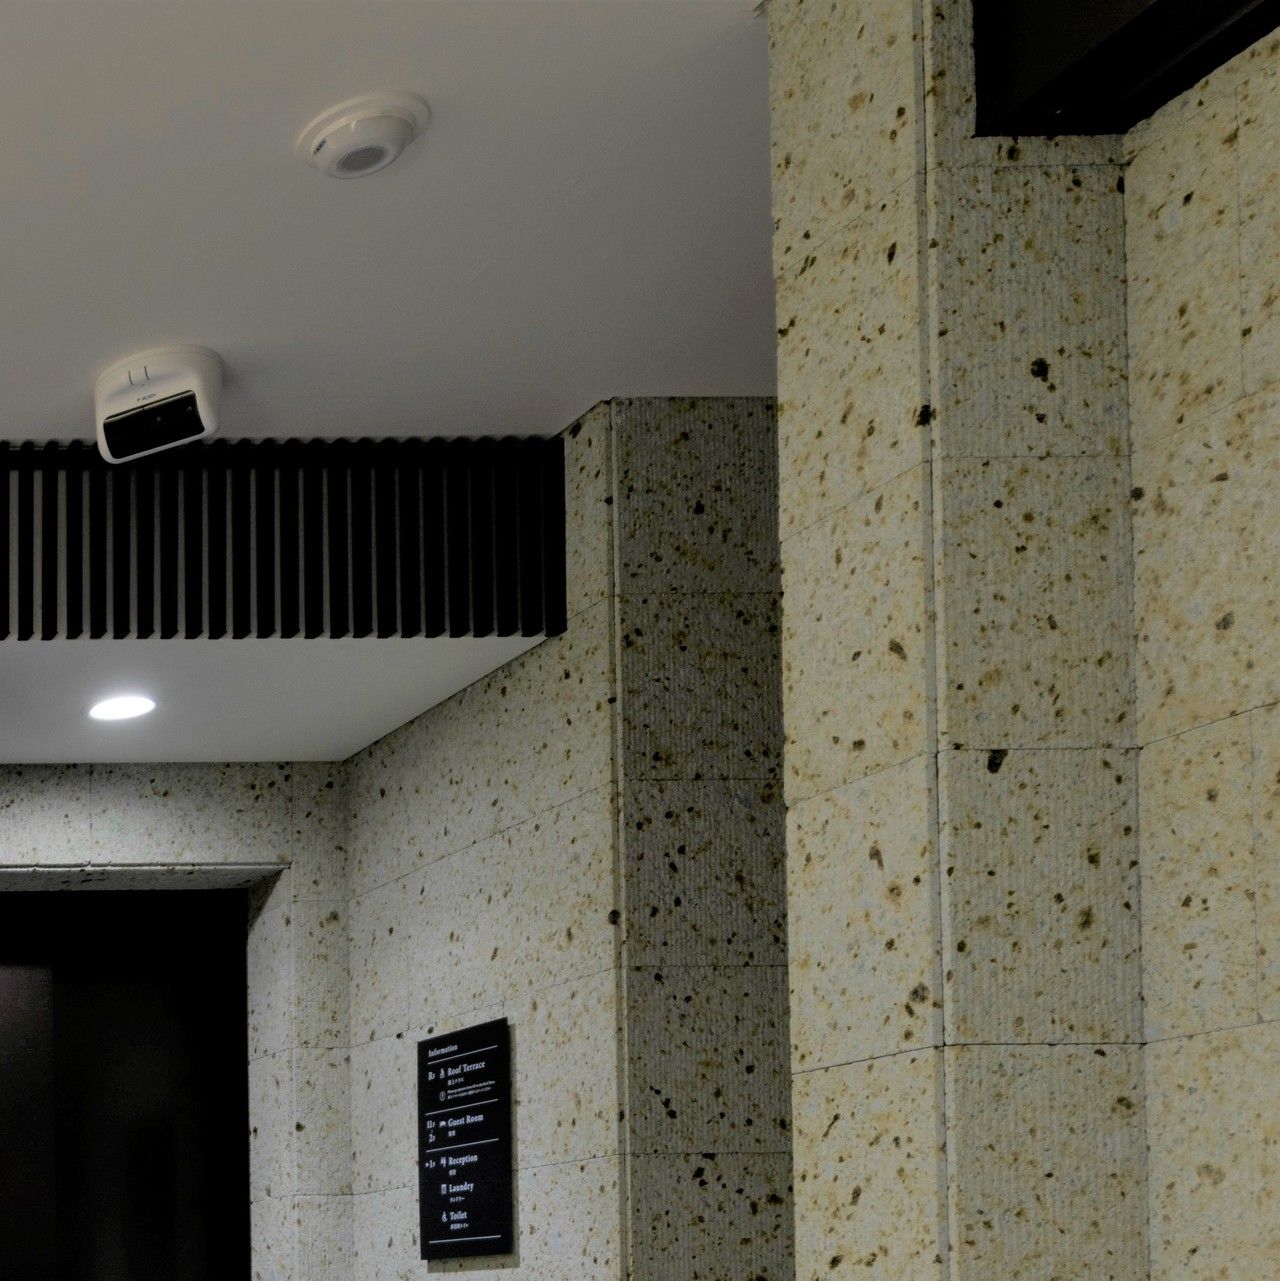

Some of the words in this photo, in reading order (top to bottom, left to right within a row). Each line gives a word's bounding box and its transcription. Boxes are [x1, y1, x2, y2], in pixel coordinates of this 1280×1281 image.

[428, 1045, 458, 1057] Information
[447, 1065, 462, 1076] Roof
[463, 1062, 485, 1072] Terrace
[448, 1117, 465, 1127] Guest
[466, 1114, 484, 1124] Room
[448, 1155, 478, 1165] Reception
[449, 1182, 474, 1192] Laundry
[450, 1211, 467, 1220] Toilet
